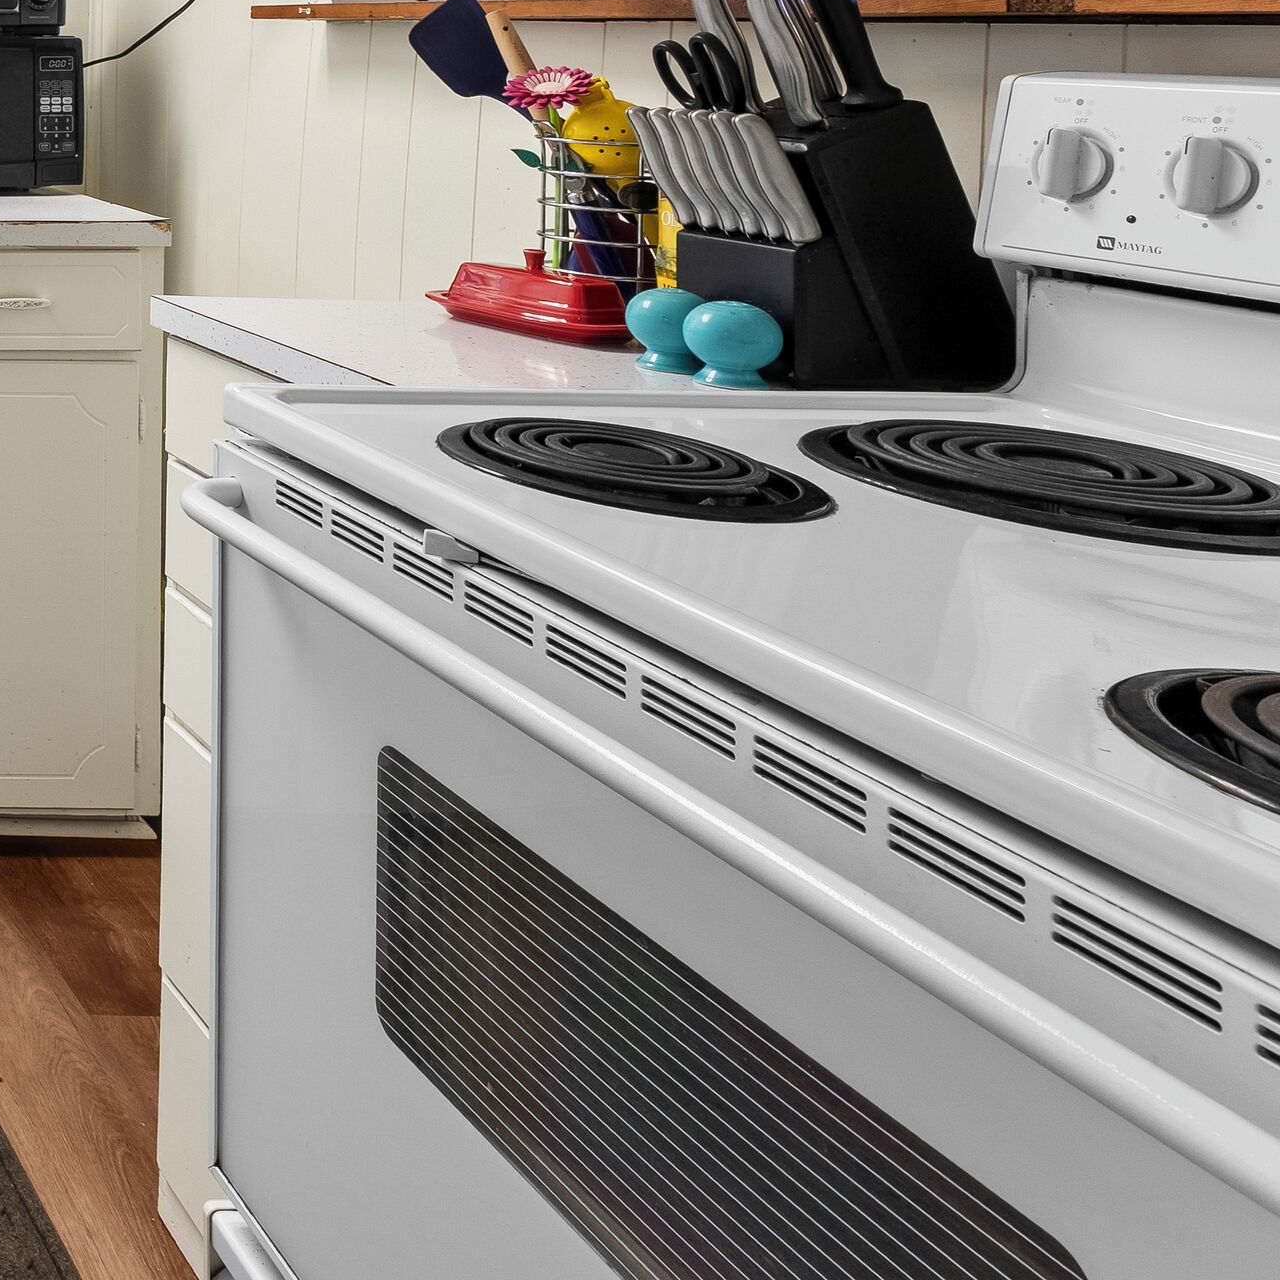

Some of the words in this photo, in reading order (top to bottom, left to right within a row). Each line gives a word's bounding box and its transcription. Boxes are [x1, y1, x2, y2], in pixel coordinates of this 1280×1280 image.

[1074, 117, 1089, 125] OFF
[1182, 116, 1208, 124] FRONT
[1212, 126, 1229, 134] OFF
[1246, 135, 1264, 152] HIGH
[1117, 240, 1162, 255] MAYTAG
